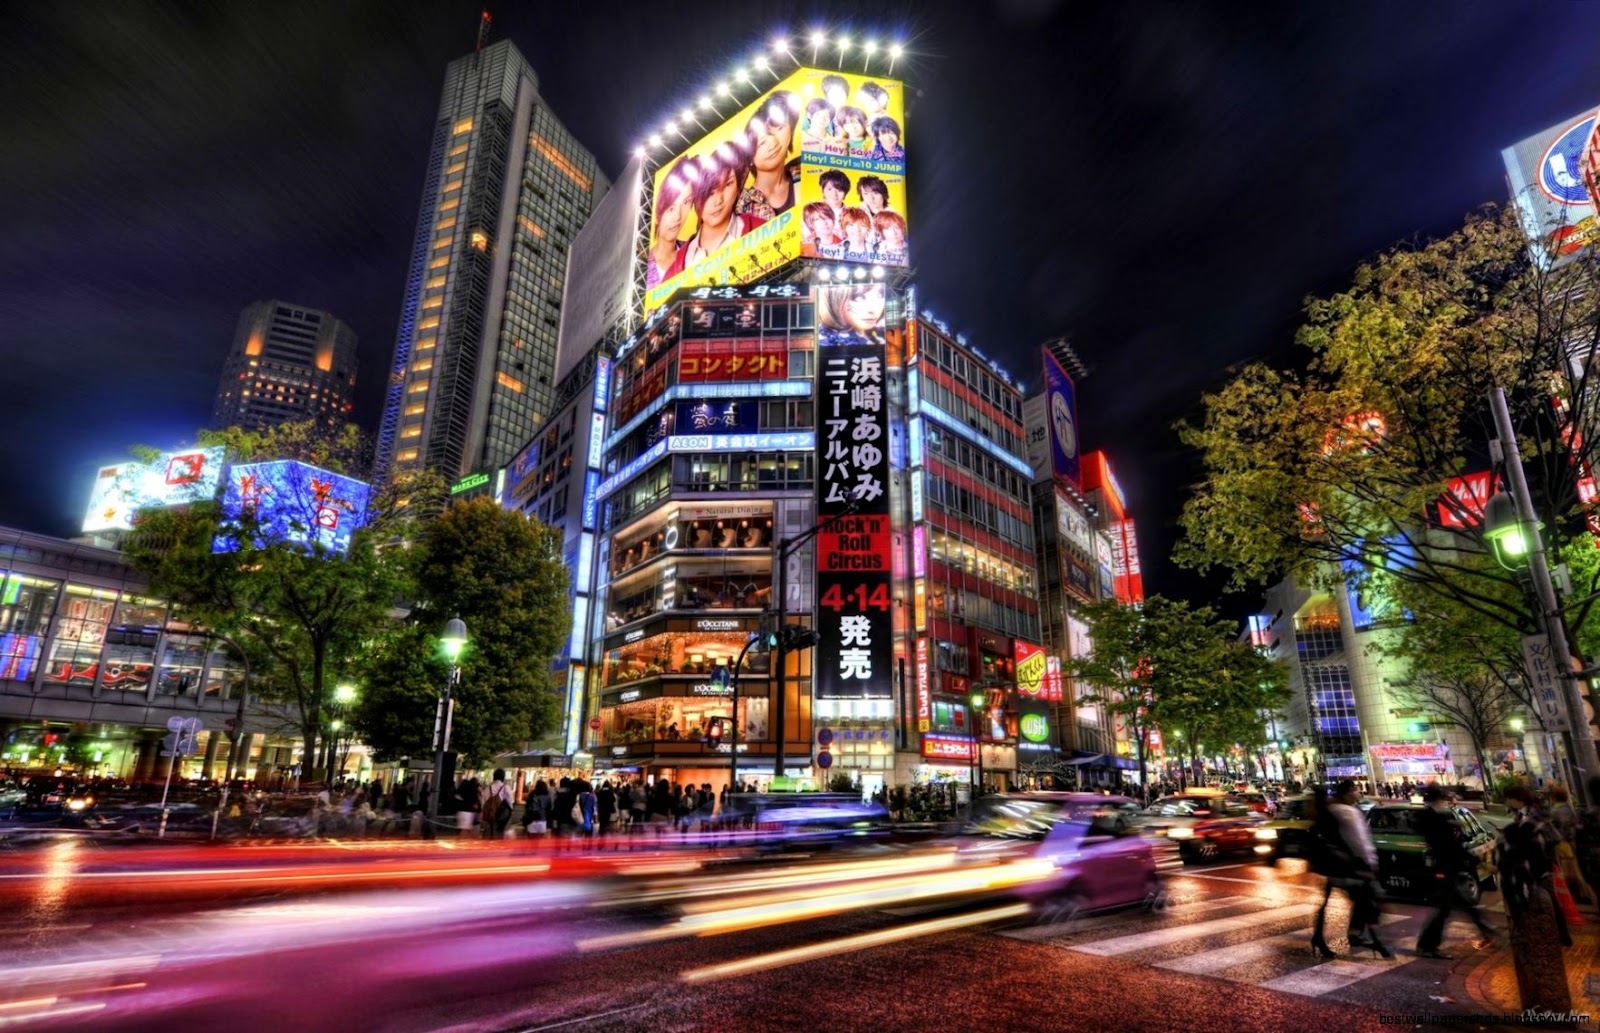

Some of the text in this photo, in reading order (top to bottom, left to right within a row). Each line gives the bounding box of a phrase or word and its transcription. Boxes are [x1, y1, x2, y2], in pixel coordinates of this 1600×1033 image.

[803, 153, 822, 164] Hey!
[830, 157, 851, 167] Say!
[874, 164, 902, 173] JUMP
[680, 354, 785, 375] コンタクト
[824, 358, 850, 503] ニューアルバム
[851, 356, 884, 501] 浜崎あゆみ
[672, 435, 812, 449] AEON 英会話イーオン
[1452, 477, 1486, 499] H&M
[706, 506, 763, 515] Natural Dining
[839, 535, 871, 551] Roll
[828, 551, 882, 569] Circus
[839, 614, 872, 680] 発売
[1023, 716, 1047, 735] LUSH
